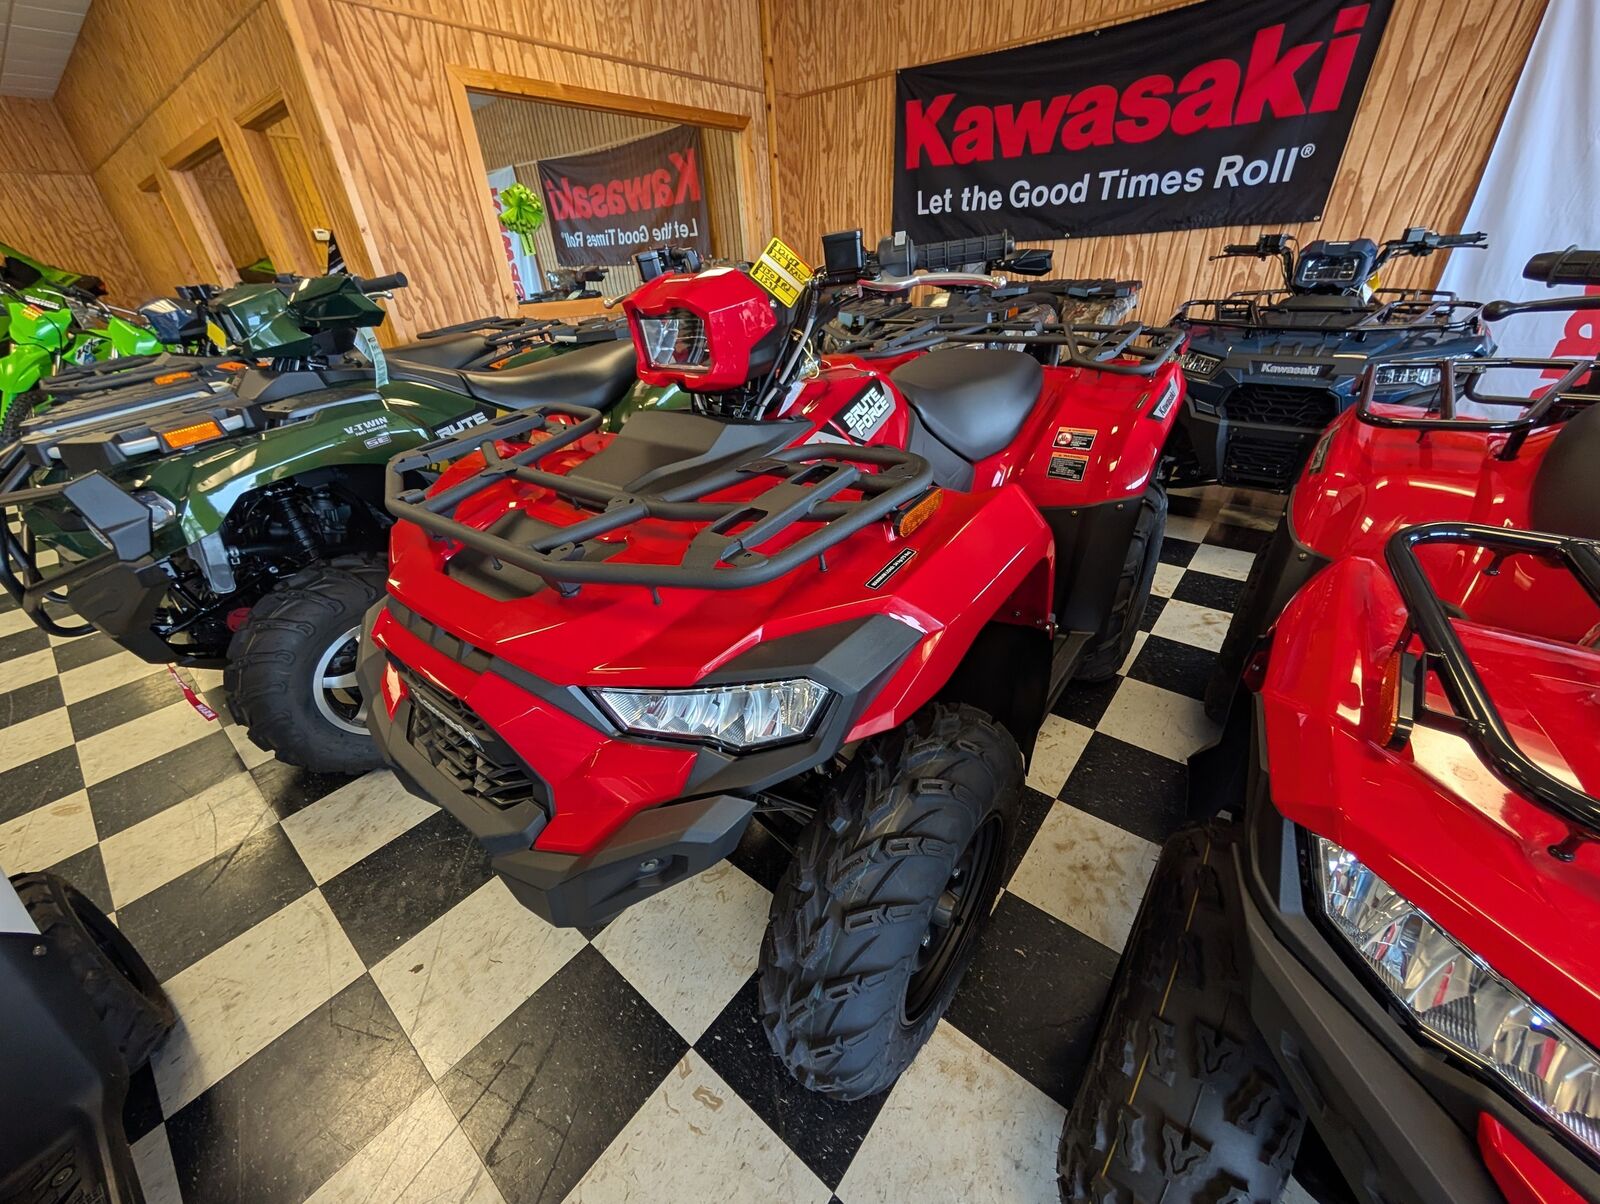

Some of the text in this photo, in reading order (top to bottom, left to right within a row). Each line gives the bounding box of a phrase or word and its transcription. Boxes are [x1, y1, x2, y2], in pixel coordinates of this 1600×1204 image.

[905, 3, 1370, 170] Kawasaki
[917, 187, 952, 215] Let
[961, 185, 1003, 212] the
[1009, 174, 1090, 209] Good
[1098, 165, 1204, 201] Times
[1261, 363, 1320, 376] Kawasaki
[344, 416, 388, 434] V-TWIN
[843, 387, 881, 428] BRUTE
[855, 395, 890, 436] FORCE
